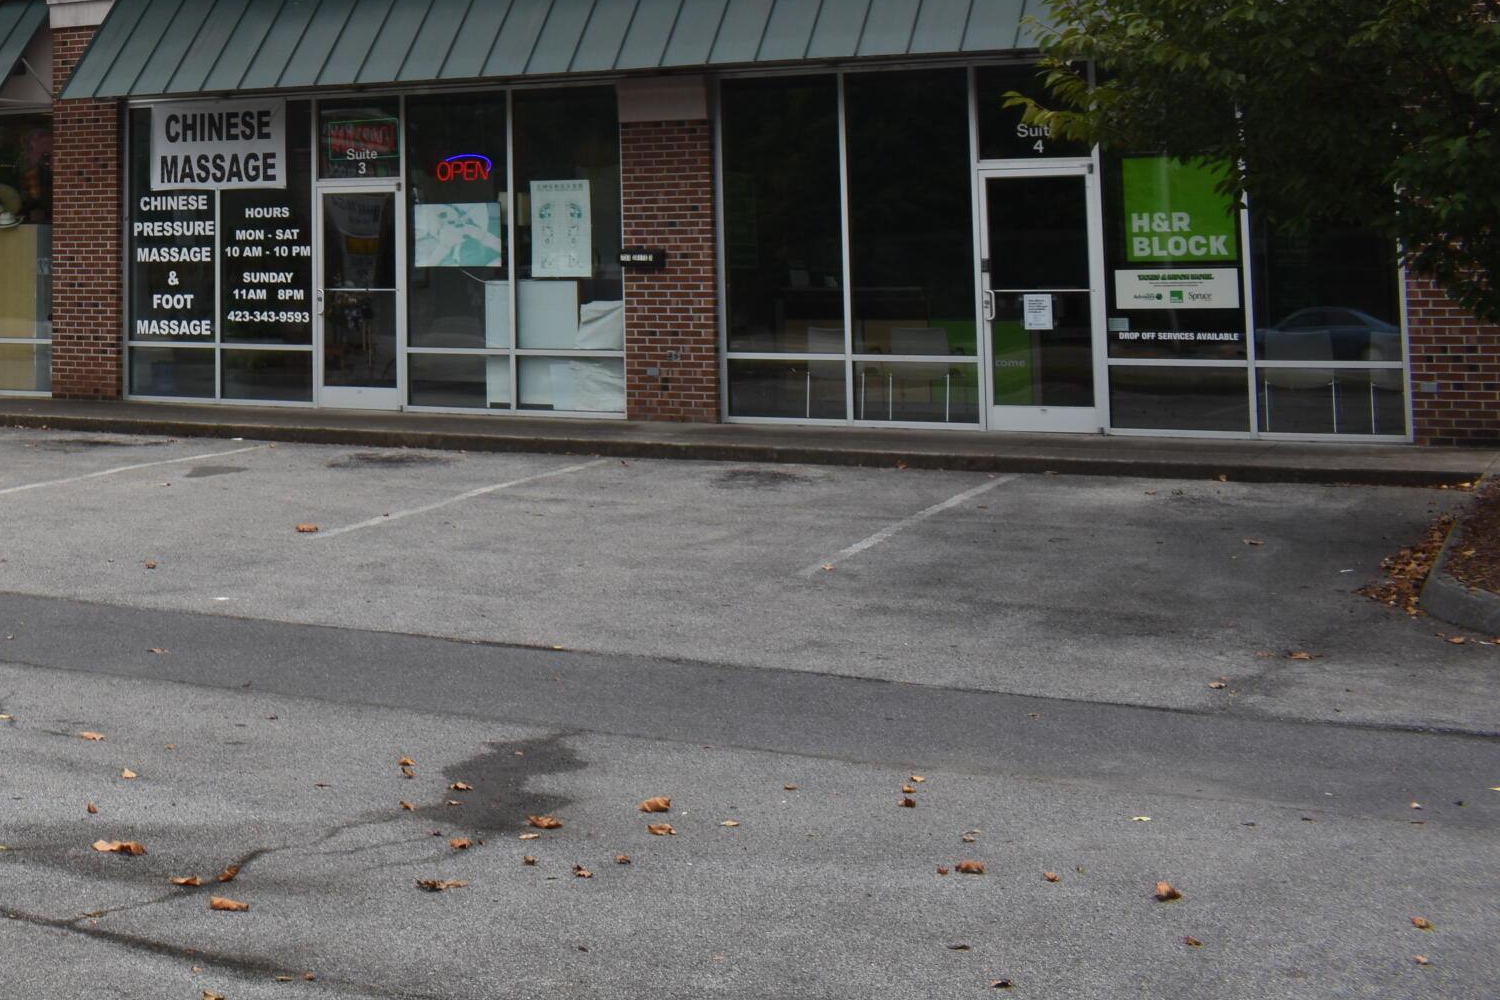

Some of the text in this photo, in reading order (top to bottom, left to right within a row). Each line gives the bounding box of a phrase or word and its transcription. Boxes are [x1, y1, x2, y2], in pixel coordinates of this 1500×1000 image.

[165, 110, 272, 143] CHINESE
[1016, 123, 1052, 138] Suit
[346, 148, 378, 160] Suite
[1033, 140, 1044, 153] 4
[160, 152, 277, 183] MASSAGE
[358, 162, 366, 174] 3
[436, 161, 489, 182] OPEN
[140, 195, 208, 211] CHINESE
[245, 207, 290, 218] HOURS
[133, 221, 215, 236] PRESSURE
[1131, 212, 1191, 232] H&R
[235, 230, 265, 240] MON
[275, 229, 300, 240] SAT
[225, 246, 240, 257] 10
[243, 246, 262, 257] AM
[273, 246, 289, 257] 10
[292, 246, 311, 257] PM
[1133, 235, 1229, 257] BLOCK
[137, 247, 211, 262] MASSAGE
[167, 270, 179, 285] &
[243, 272, 294, 283] SUNDAY
[153, 294, 194, 309] FOOT
[233, 289, 304, 300] 11AM 8PM
[227, 311, 310, 323] 423-343-9593
[136, 320, 211, 335] MASSAGE
[1118, 332, 1240, 341] DROP OFF SERVICES AVAILABLE
